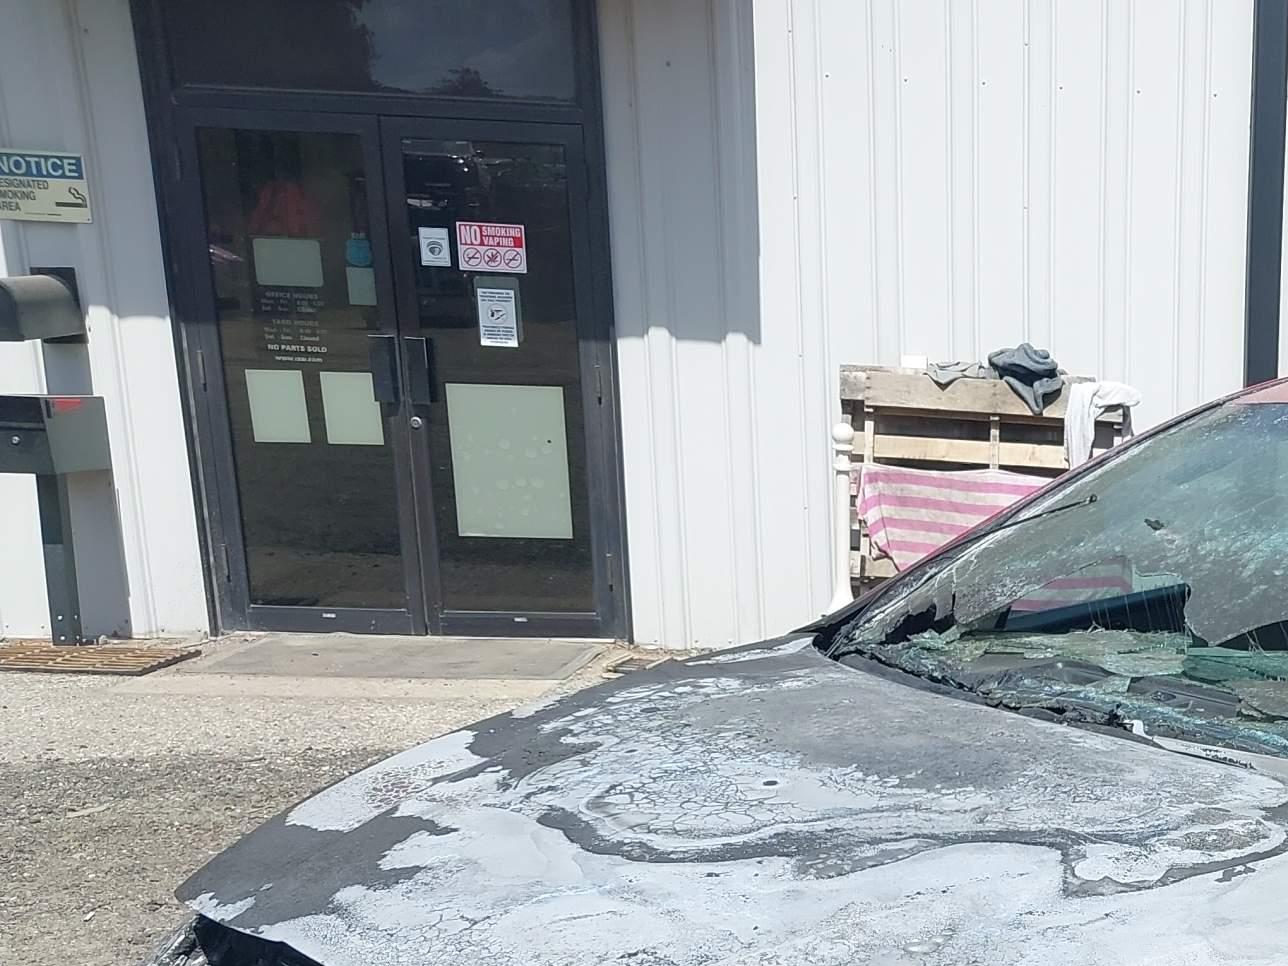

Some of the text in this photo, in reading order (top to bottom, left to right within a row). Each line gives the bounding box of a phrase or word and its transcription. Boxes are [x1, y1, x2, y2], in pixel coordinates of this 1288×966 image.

[0, 156, 79, 177] NOTICE
[460, 225, 521, 245] NO SMOKING
[482, 236, 515, 247] VAPING
